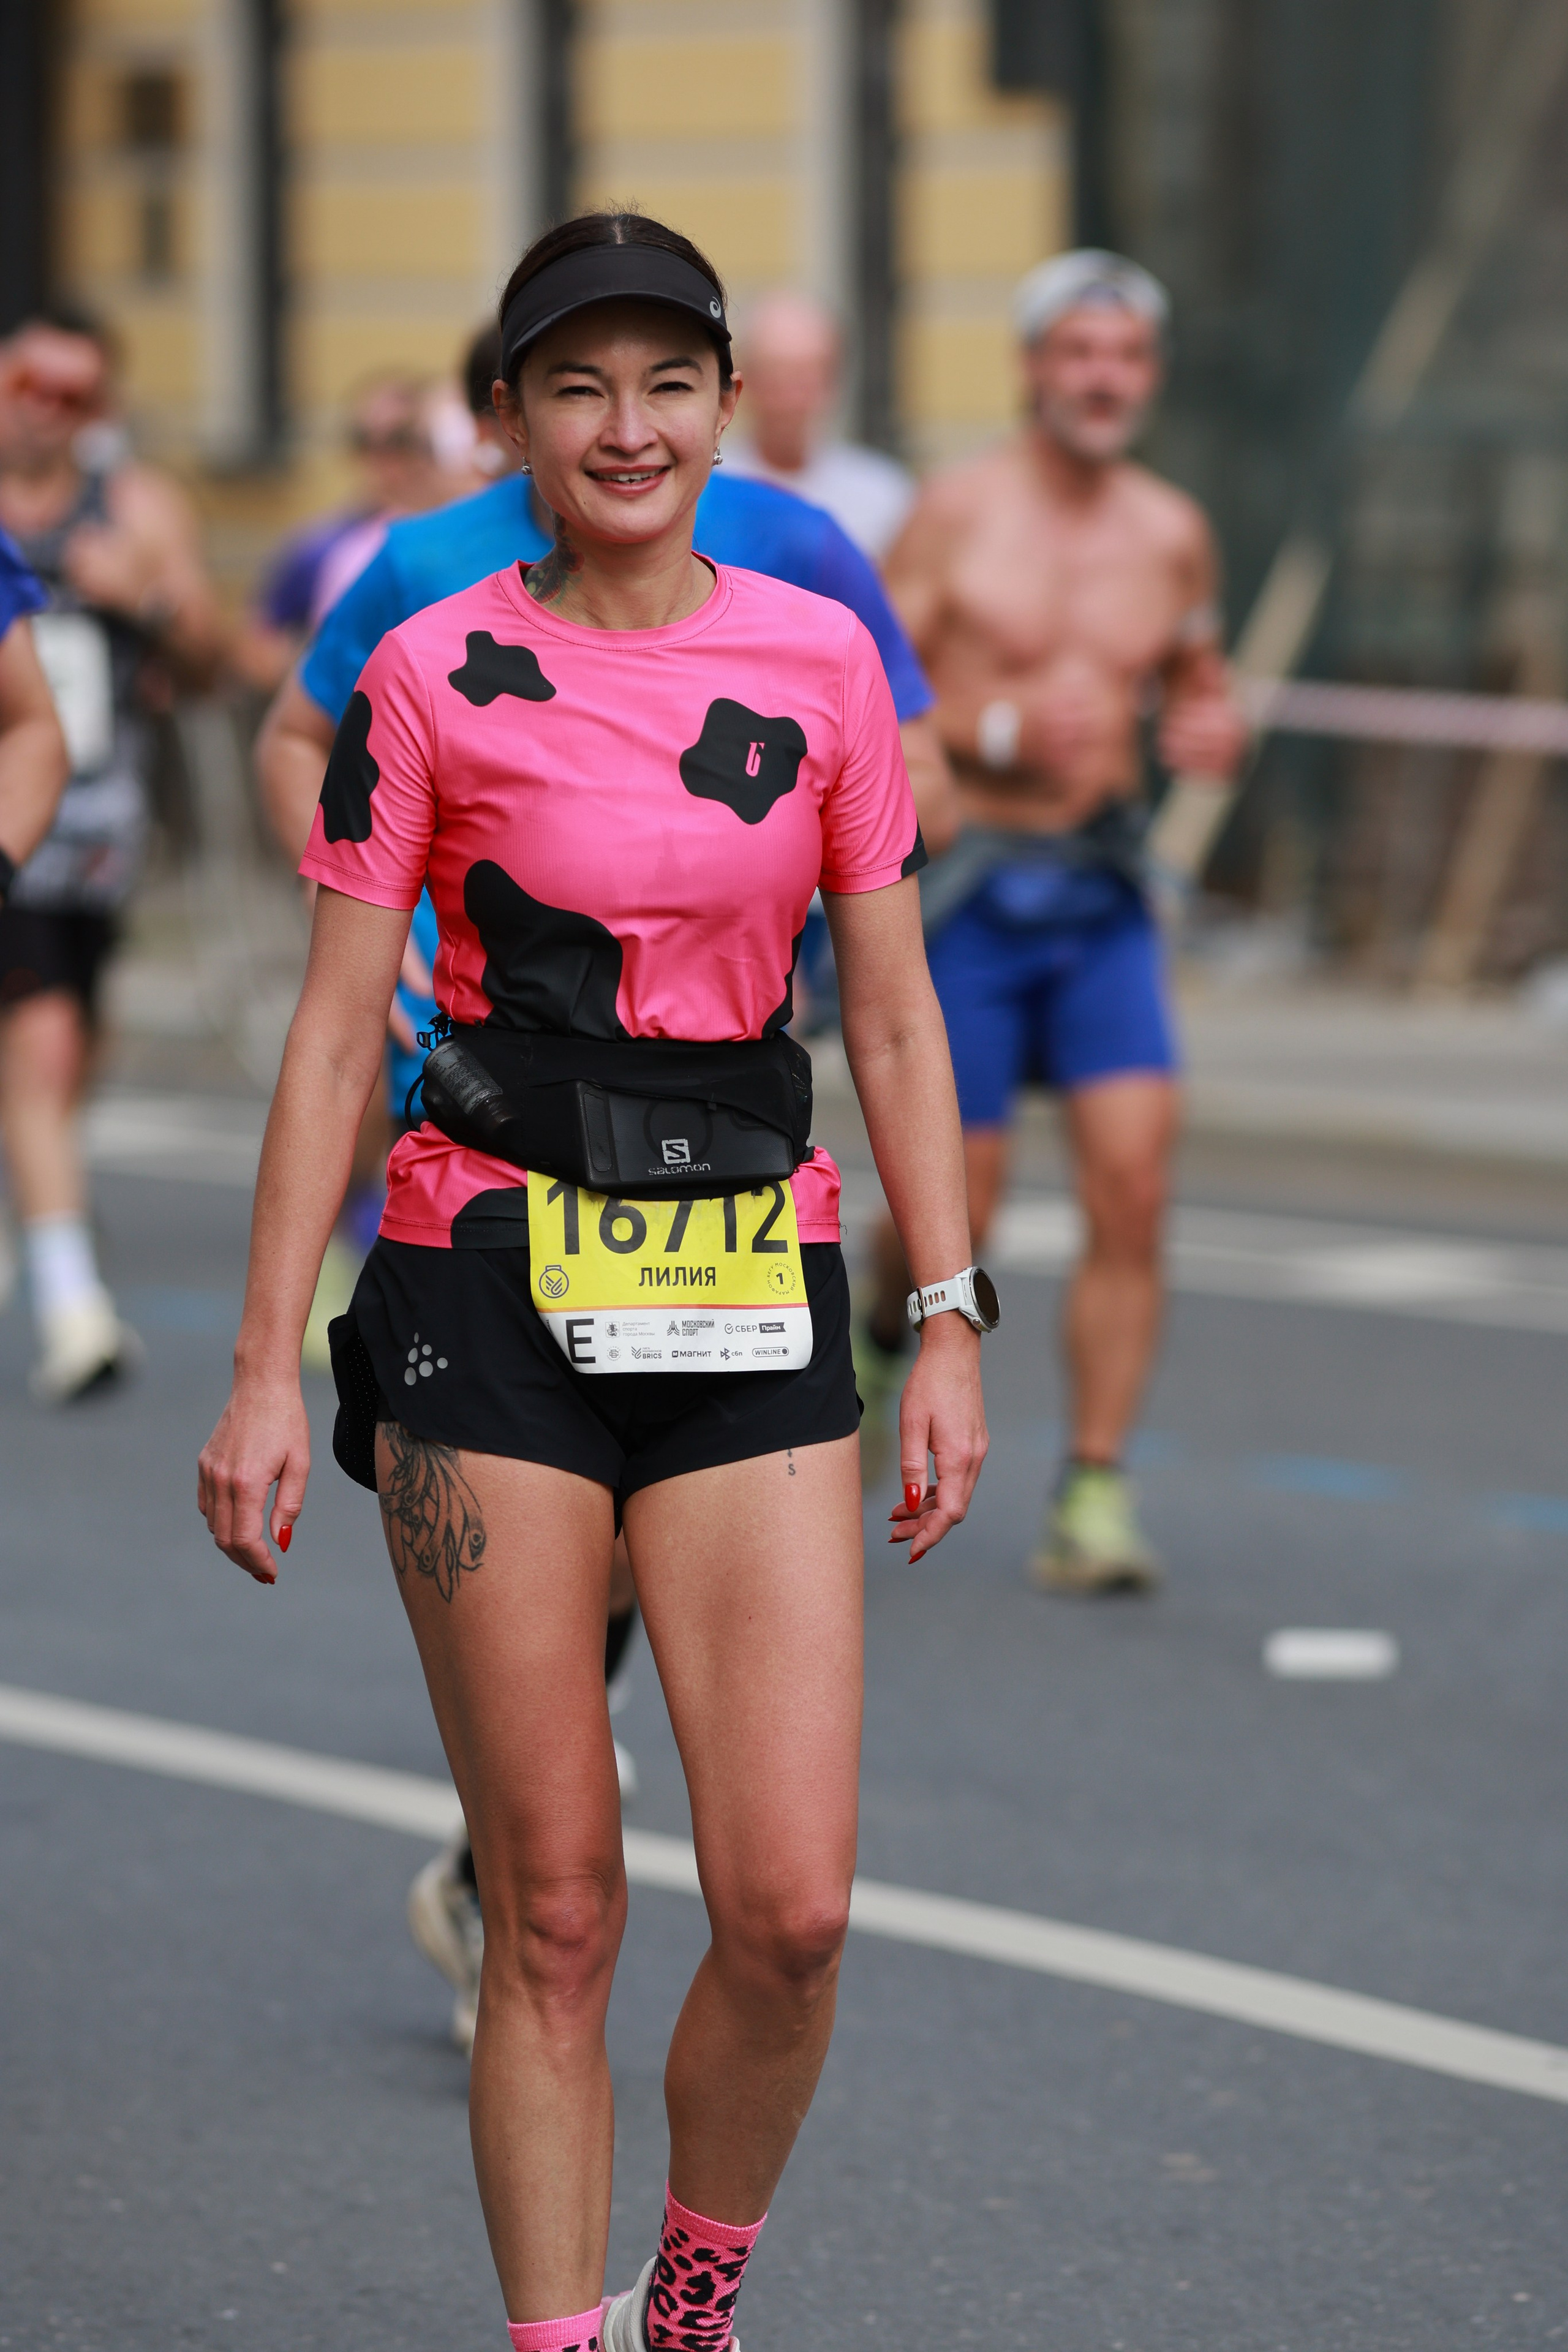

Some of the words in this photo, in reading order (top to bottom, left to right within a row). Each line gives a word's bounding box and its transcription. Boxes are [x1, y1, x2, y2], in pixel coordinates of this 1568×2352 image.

[639, 1266, 717, 1287] ЛИЛИЯ
[775, 1273, 783, 1284] 1
[682, 1319, 715, 1328] МОСКОВСКИЙ
[565, 1318, 596, 1363] E
